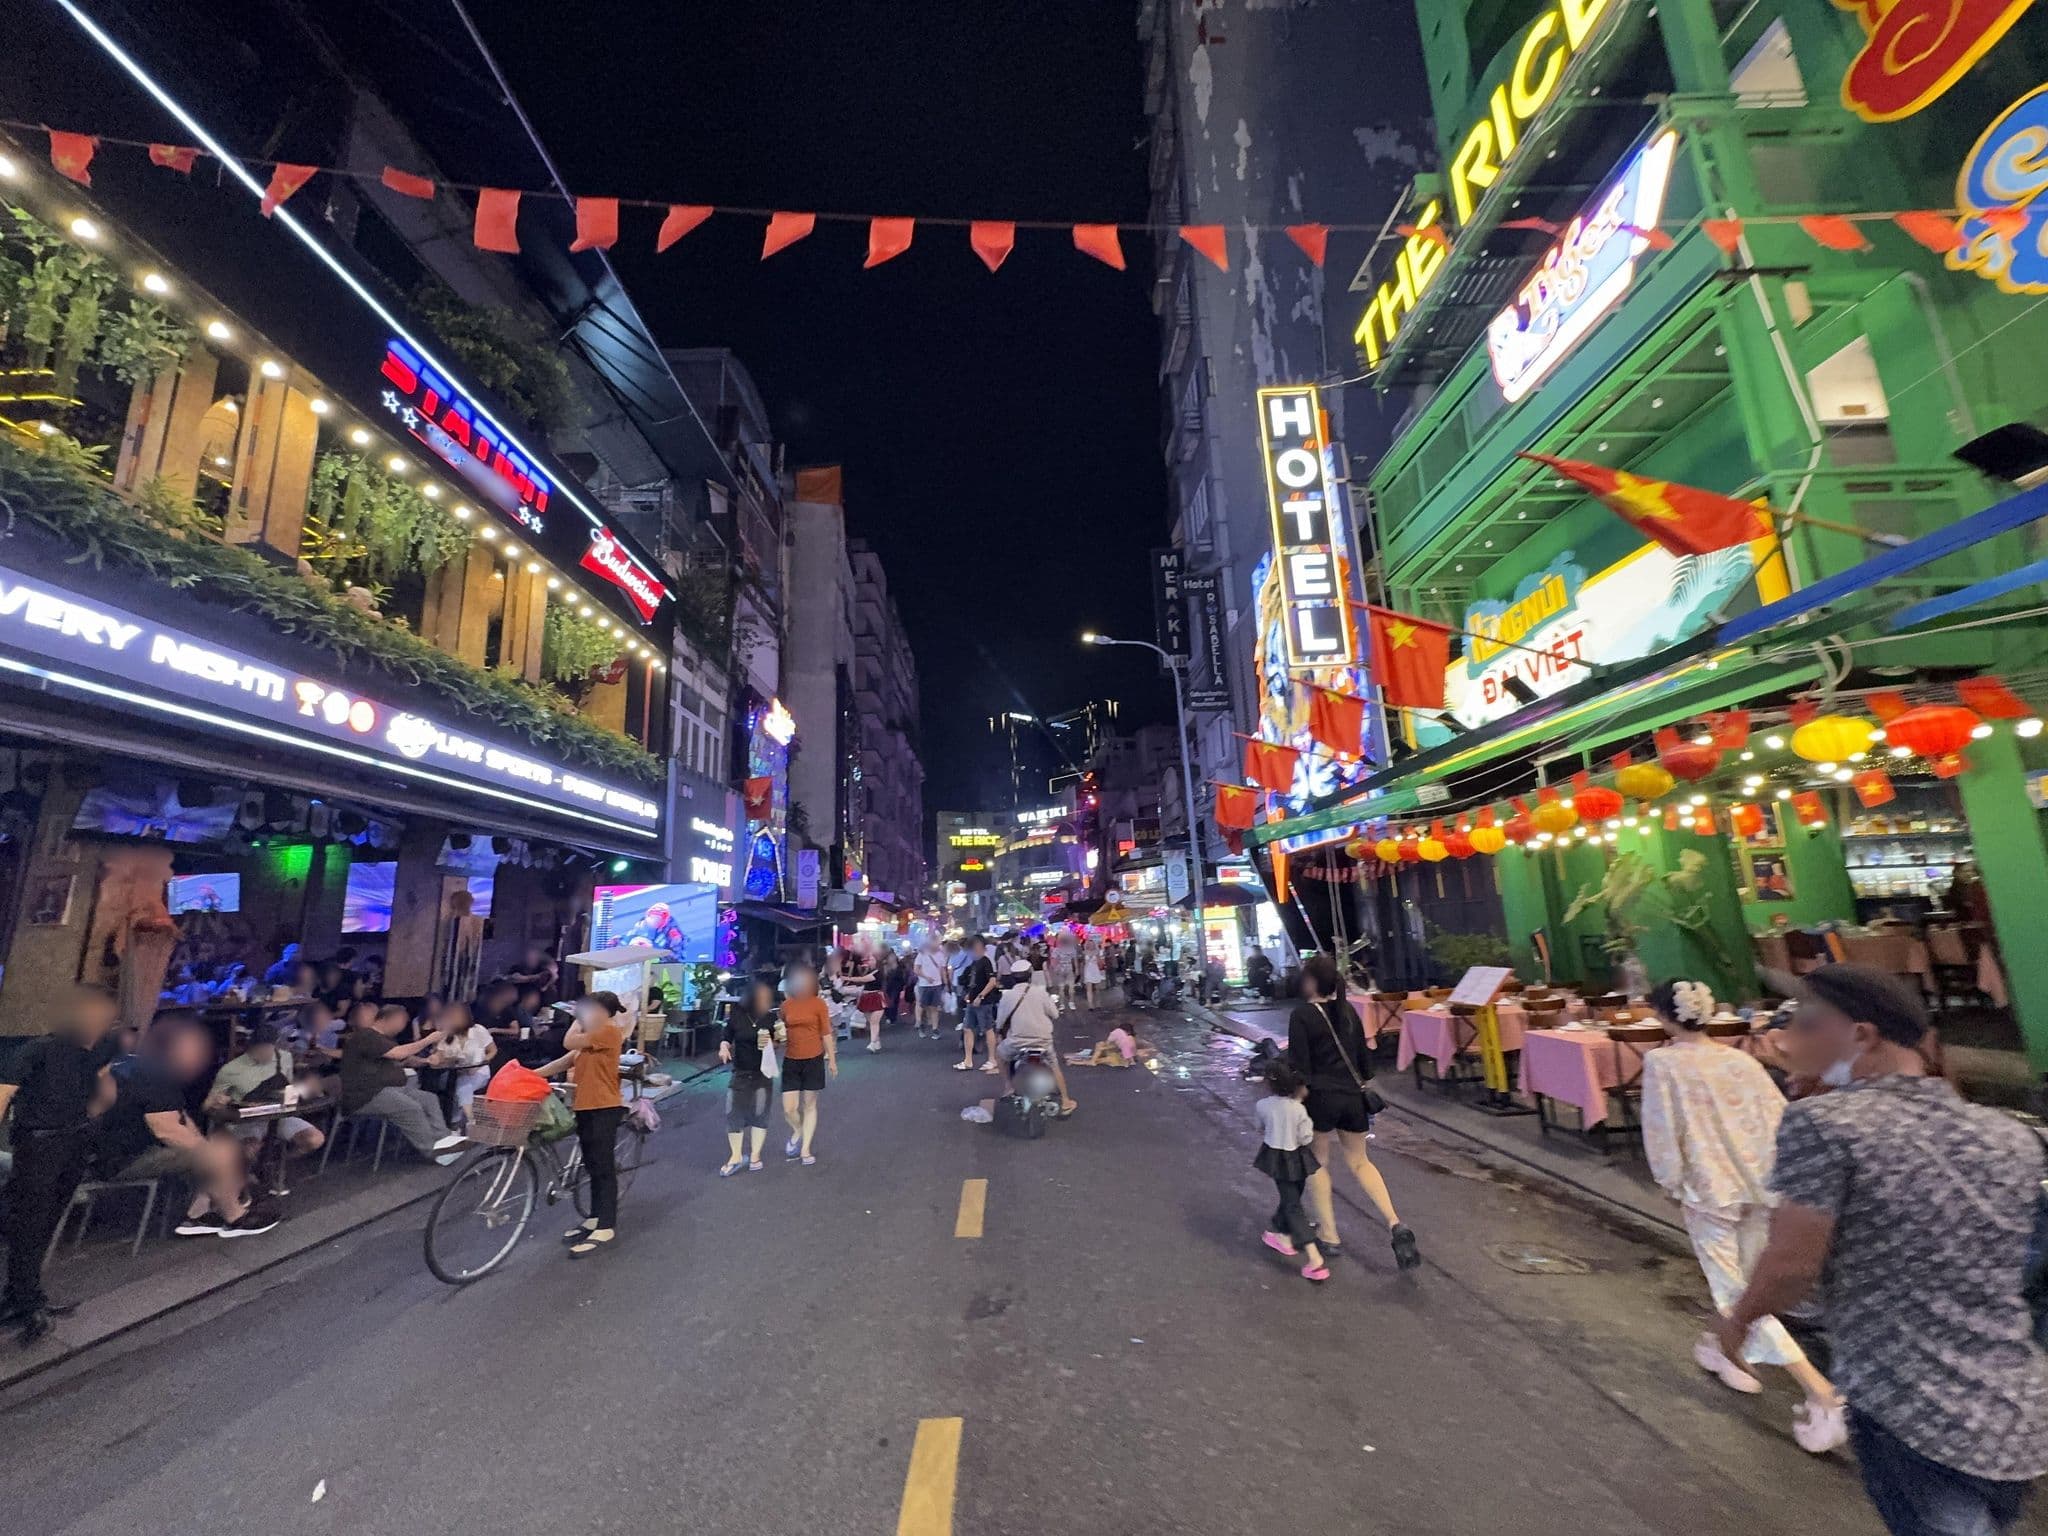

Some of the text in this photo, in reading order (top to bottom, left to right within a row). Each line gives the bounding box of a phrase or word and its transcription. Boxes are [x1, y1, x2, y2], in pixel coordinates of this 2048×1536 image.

[1269, 397, 1338, 652] HOTEL
[590, 528, 661, 608] Budweiser
[1160, 554, 1181, 649] MERAKI
[1184, 578, 1215, 590] Hotel
[436, 732, 485, 763] LIVE
